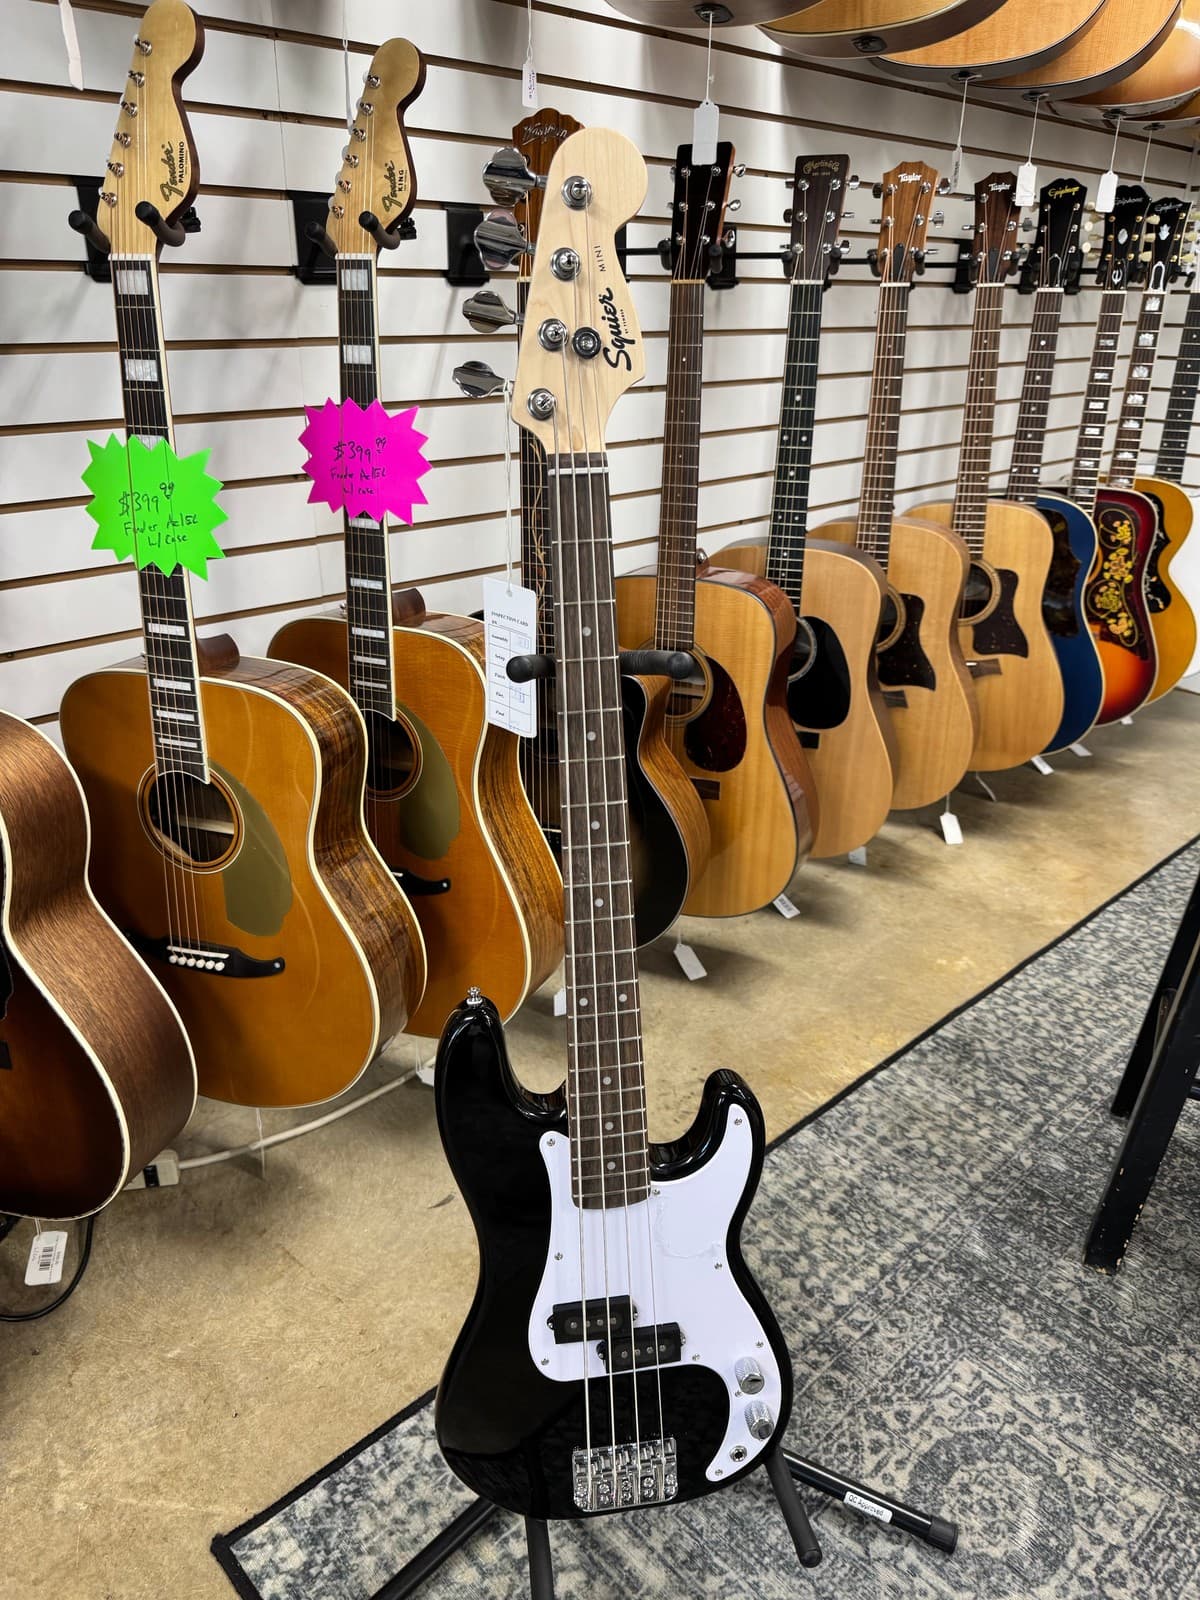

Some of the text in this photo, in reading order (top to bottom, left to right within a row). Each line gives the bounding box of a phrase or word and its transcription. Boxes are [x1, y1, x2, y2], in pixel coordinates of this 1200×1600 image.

[160, 140, 184, 202] Fender
[898, 172, 922, 183] Taylor
[381, 160, 403, 212] Fender
[988, 182, 1011, 192] Taylor
[594, 245, 606, 272] MINI
[598, 287, 636, 371] Squier
[118, 491, 160, 518] $399
[848, 1494, 884, 1517] QC Approved
